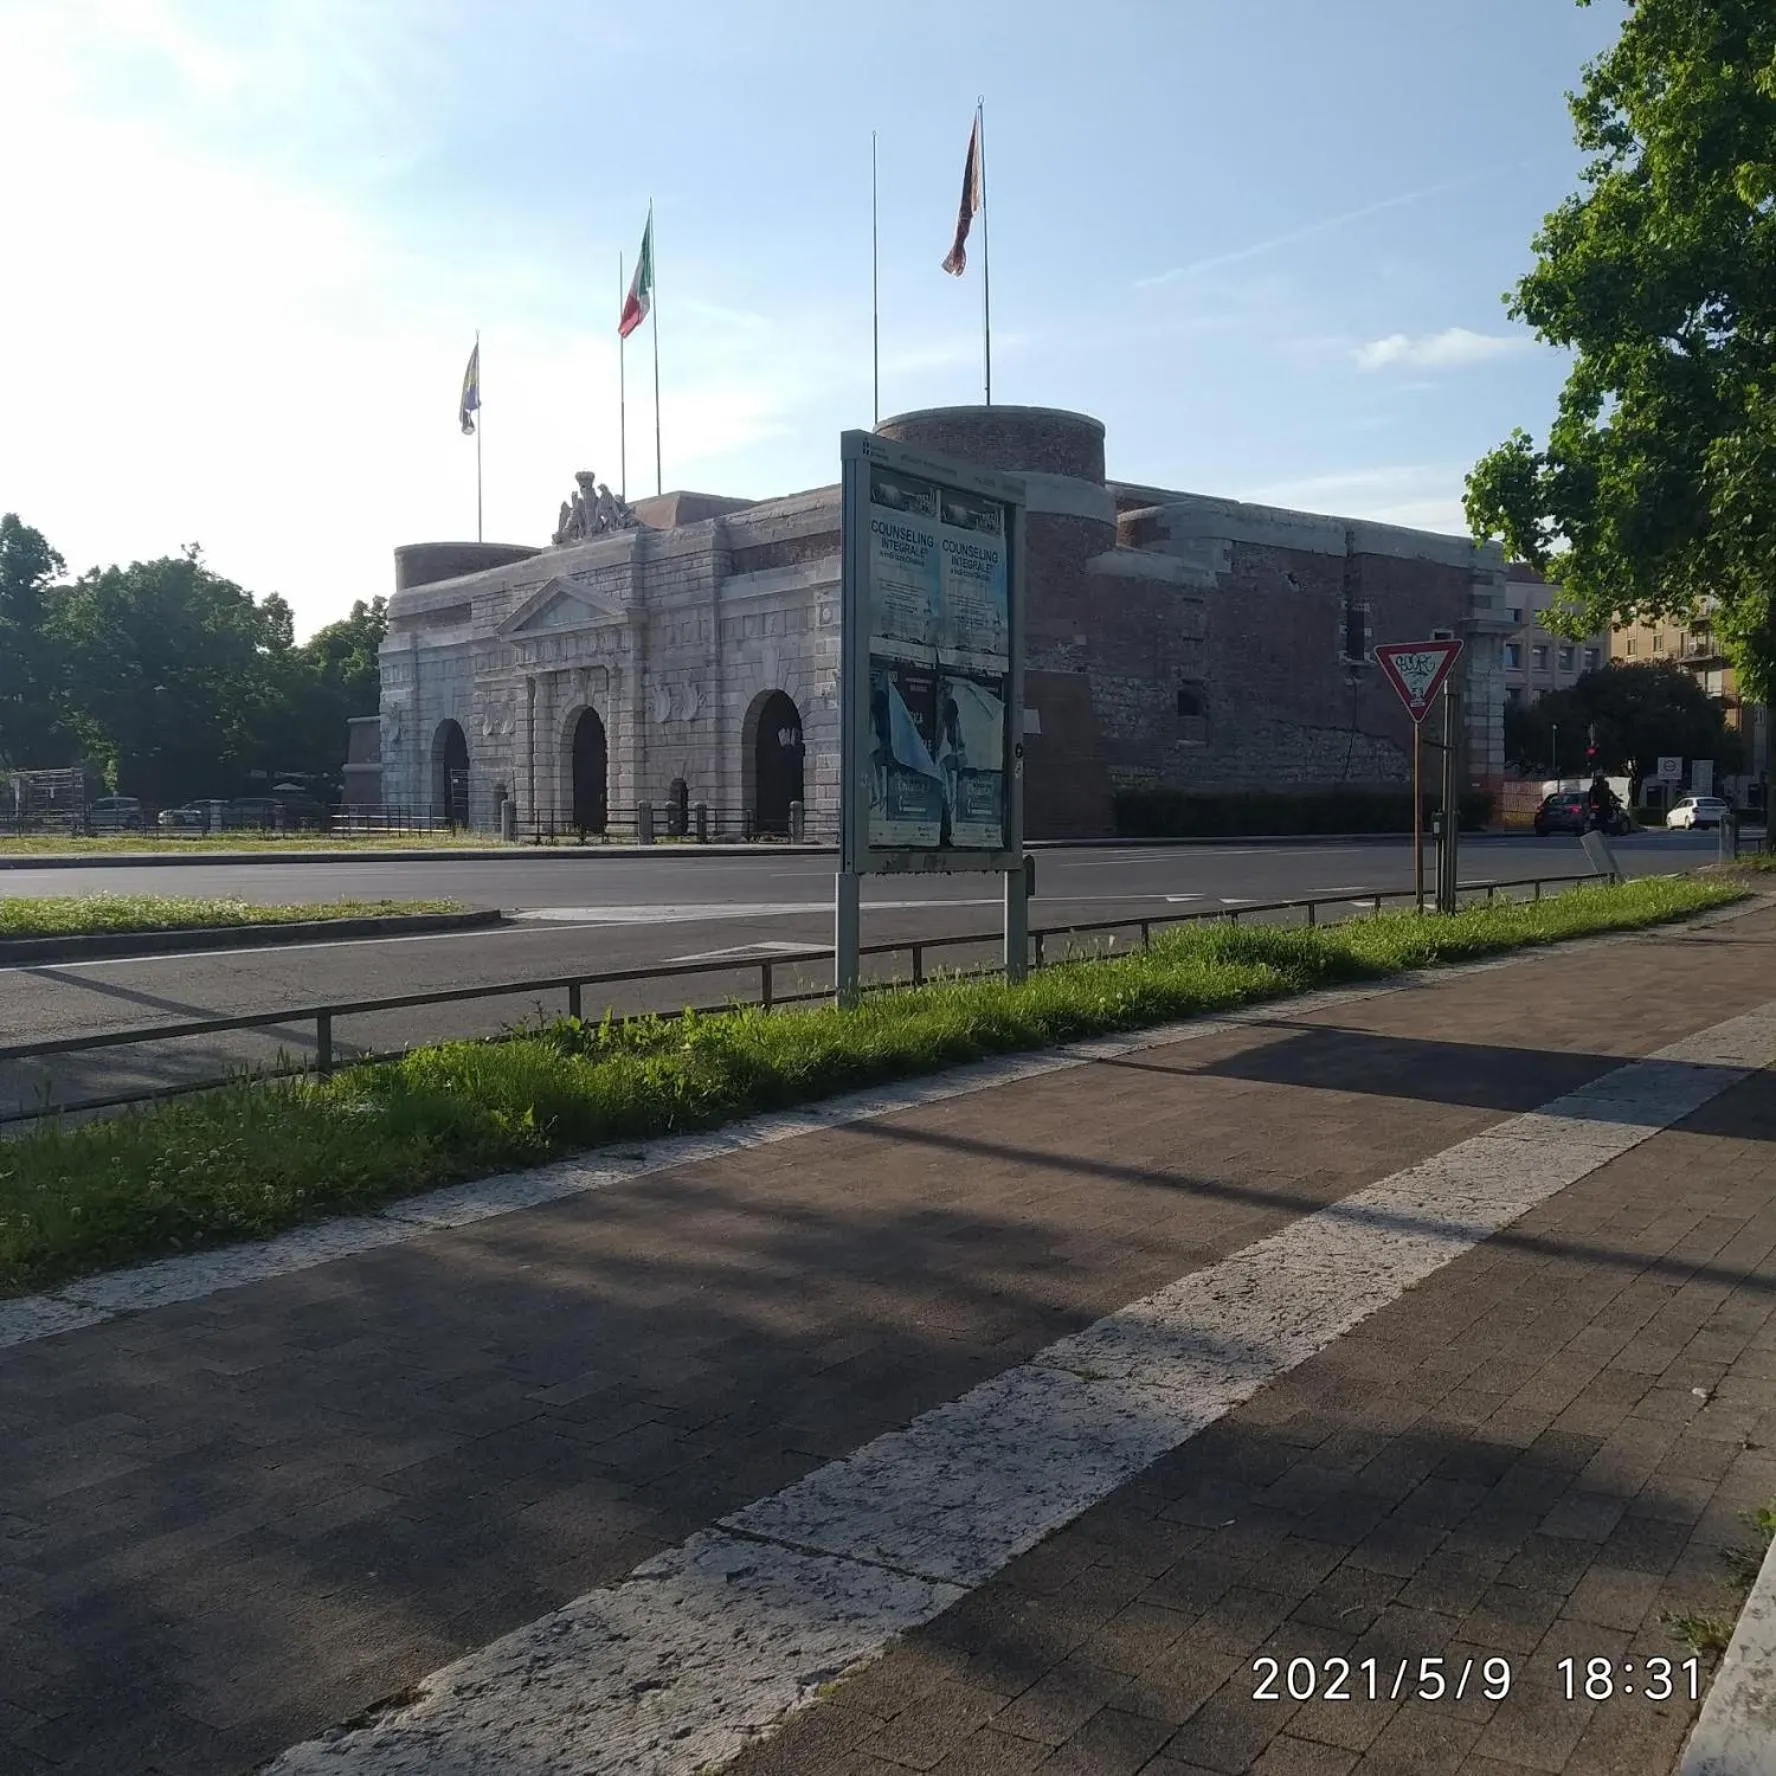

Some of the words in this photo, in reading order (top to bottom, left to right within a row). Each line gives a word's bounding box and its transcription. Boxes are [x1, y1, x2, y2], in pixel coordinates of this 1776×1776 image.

[871, 519, 934, 548] COUNSELING
[881, 536, 927, 559] INTEGRALE
[942, 539, 998, 564] COUNSELING
[951, 554, 993, 575] INTEGRALE
